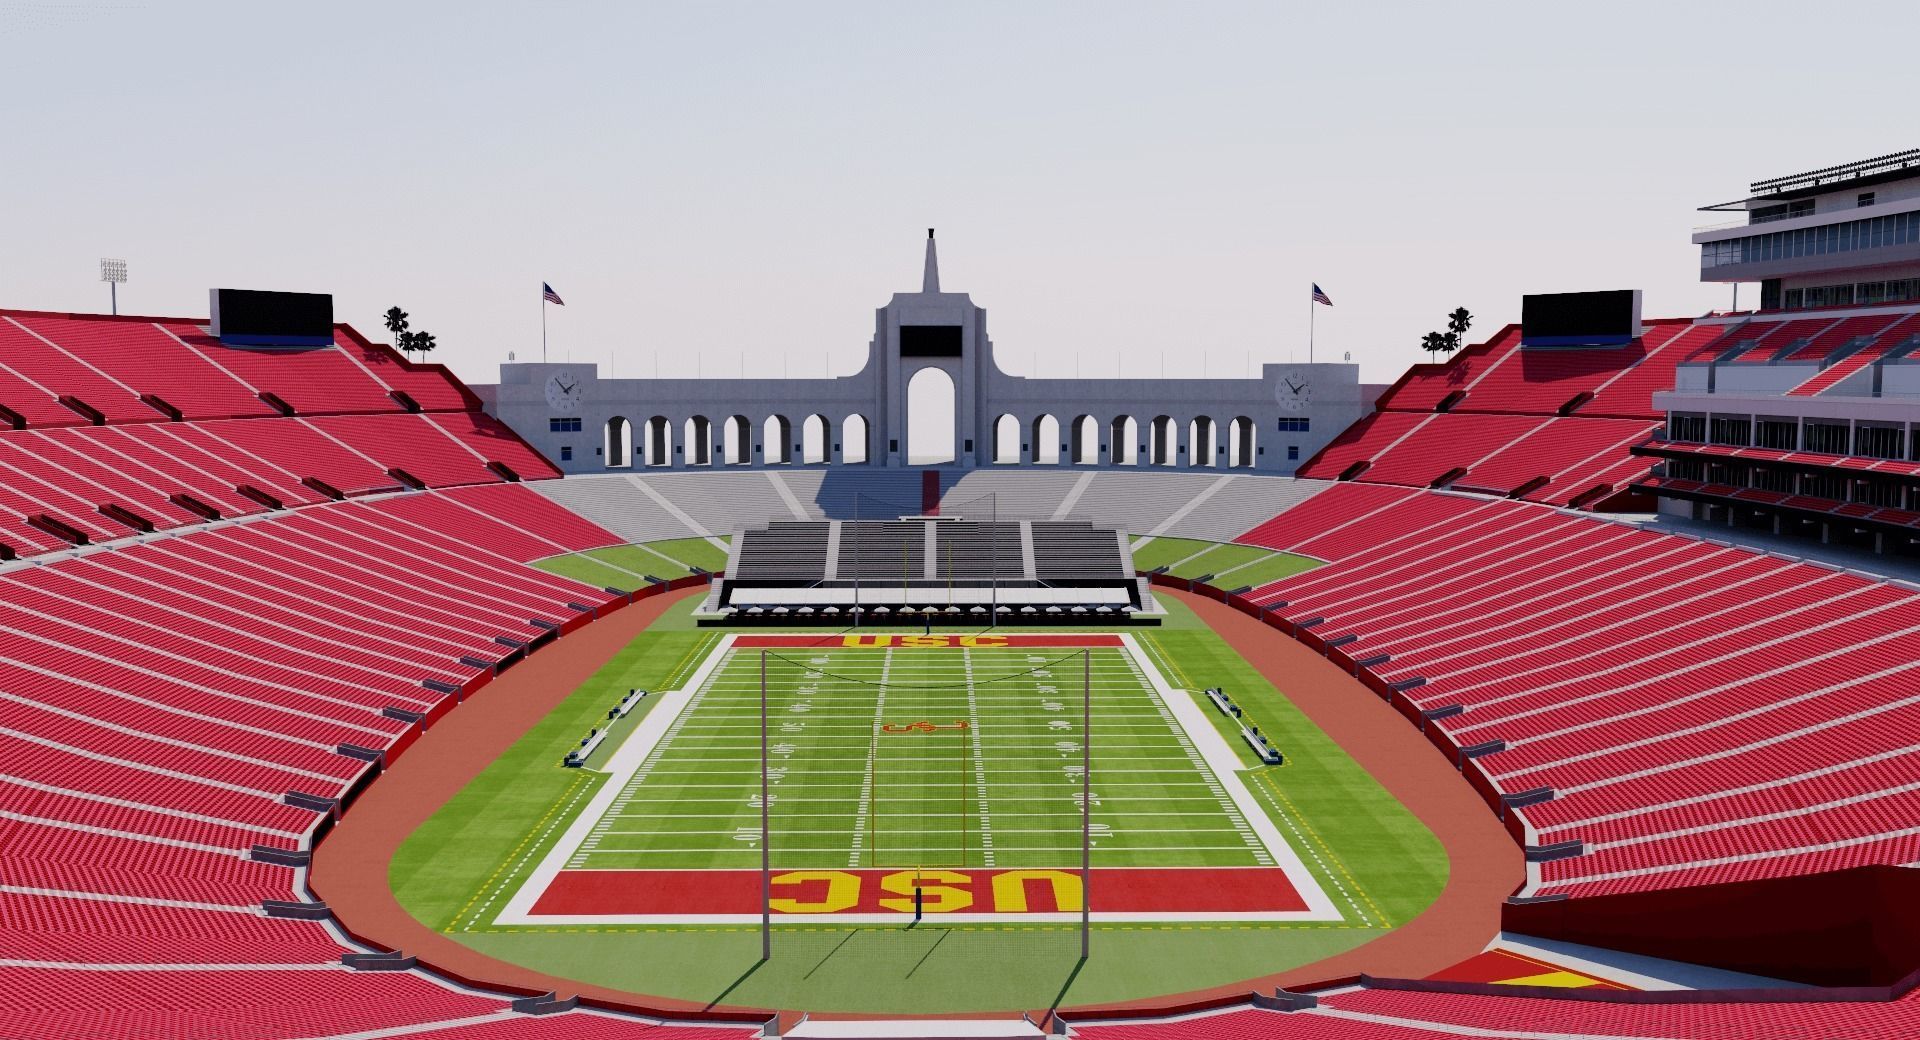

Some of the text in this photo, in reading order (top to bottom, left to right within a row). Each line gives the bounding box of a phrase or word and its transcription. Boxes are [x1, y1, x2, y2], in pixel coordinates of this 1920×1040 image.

[842, 635, 1009, 647] USC
[747, 793, 778, 808] 20
[1072, 792, 1101, 806] 20
[732, 826, 764, 841] 10
[1082, 823, 1114, 838] 10
[768, 870, 1090, 913] USC
